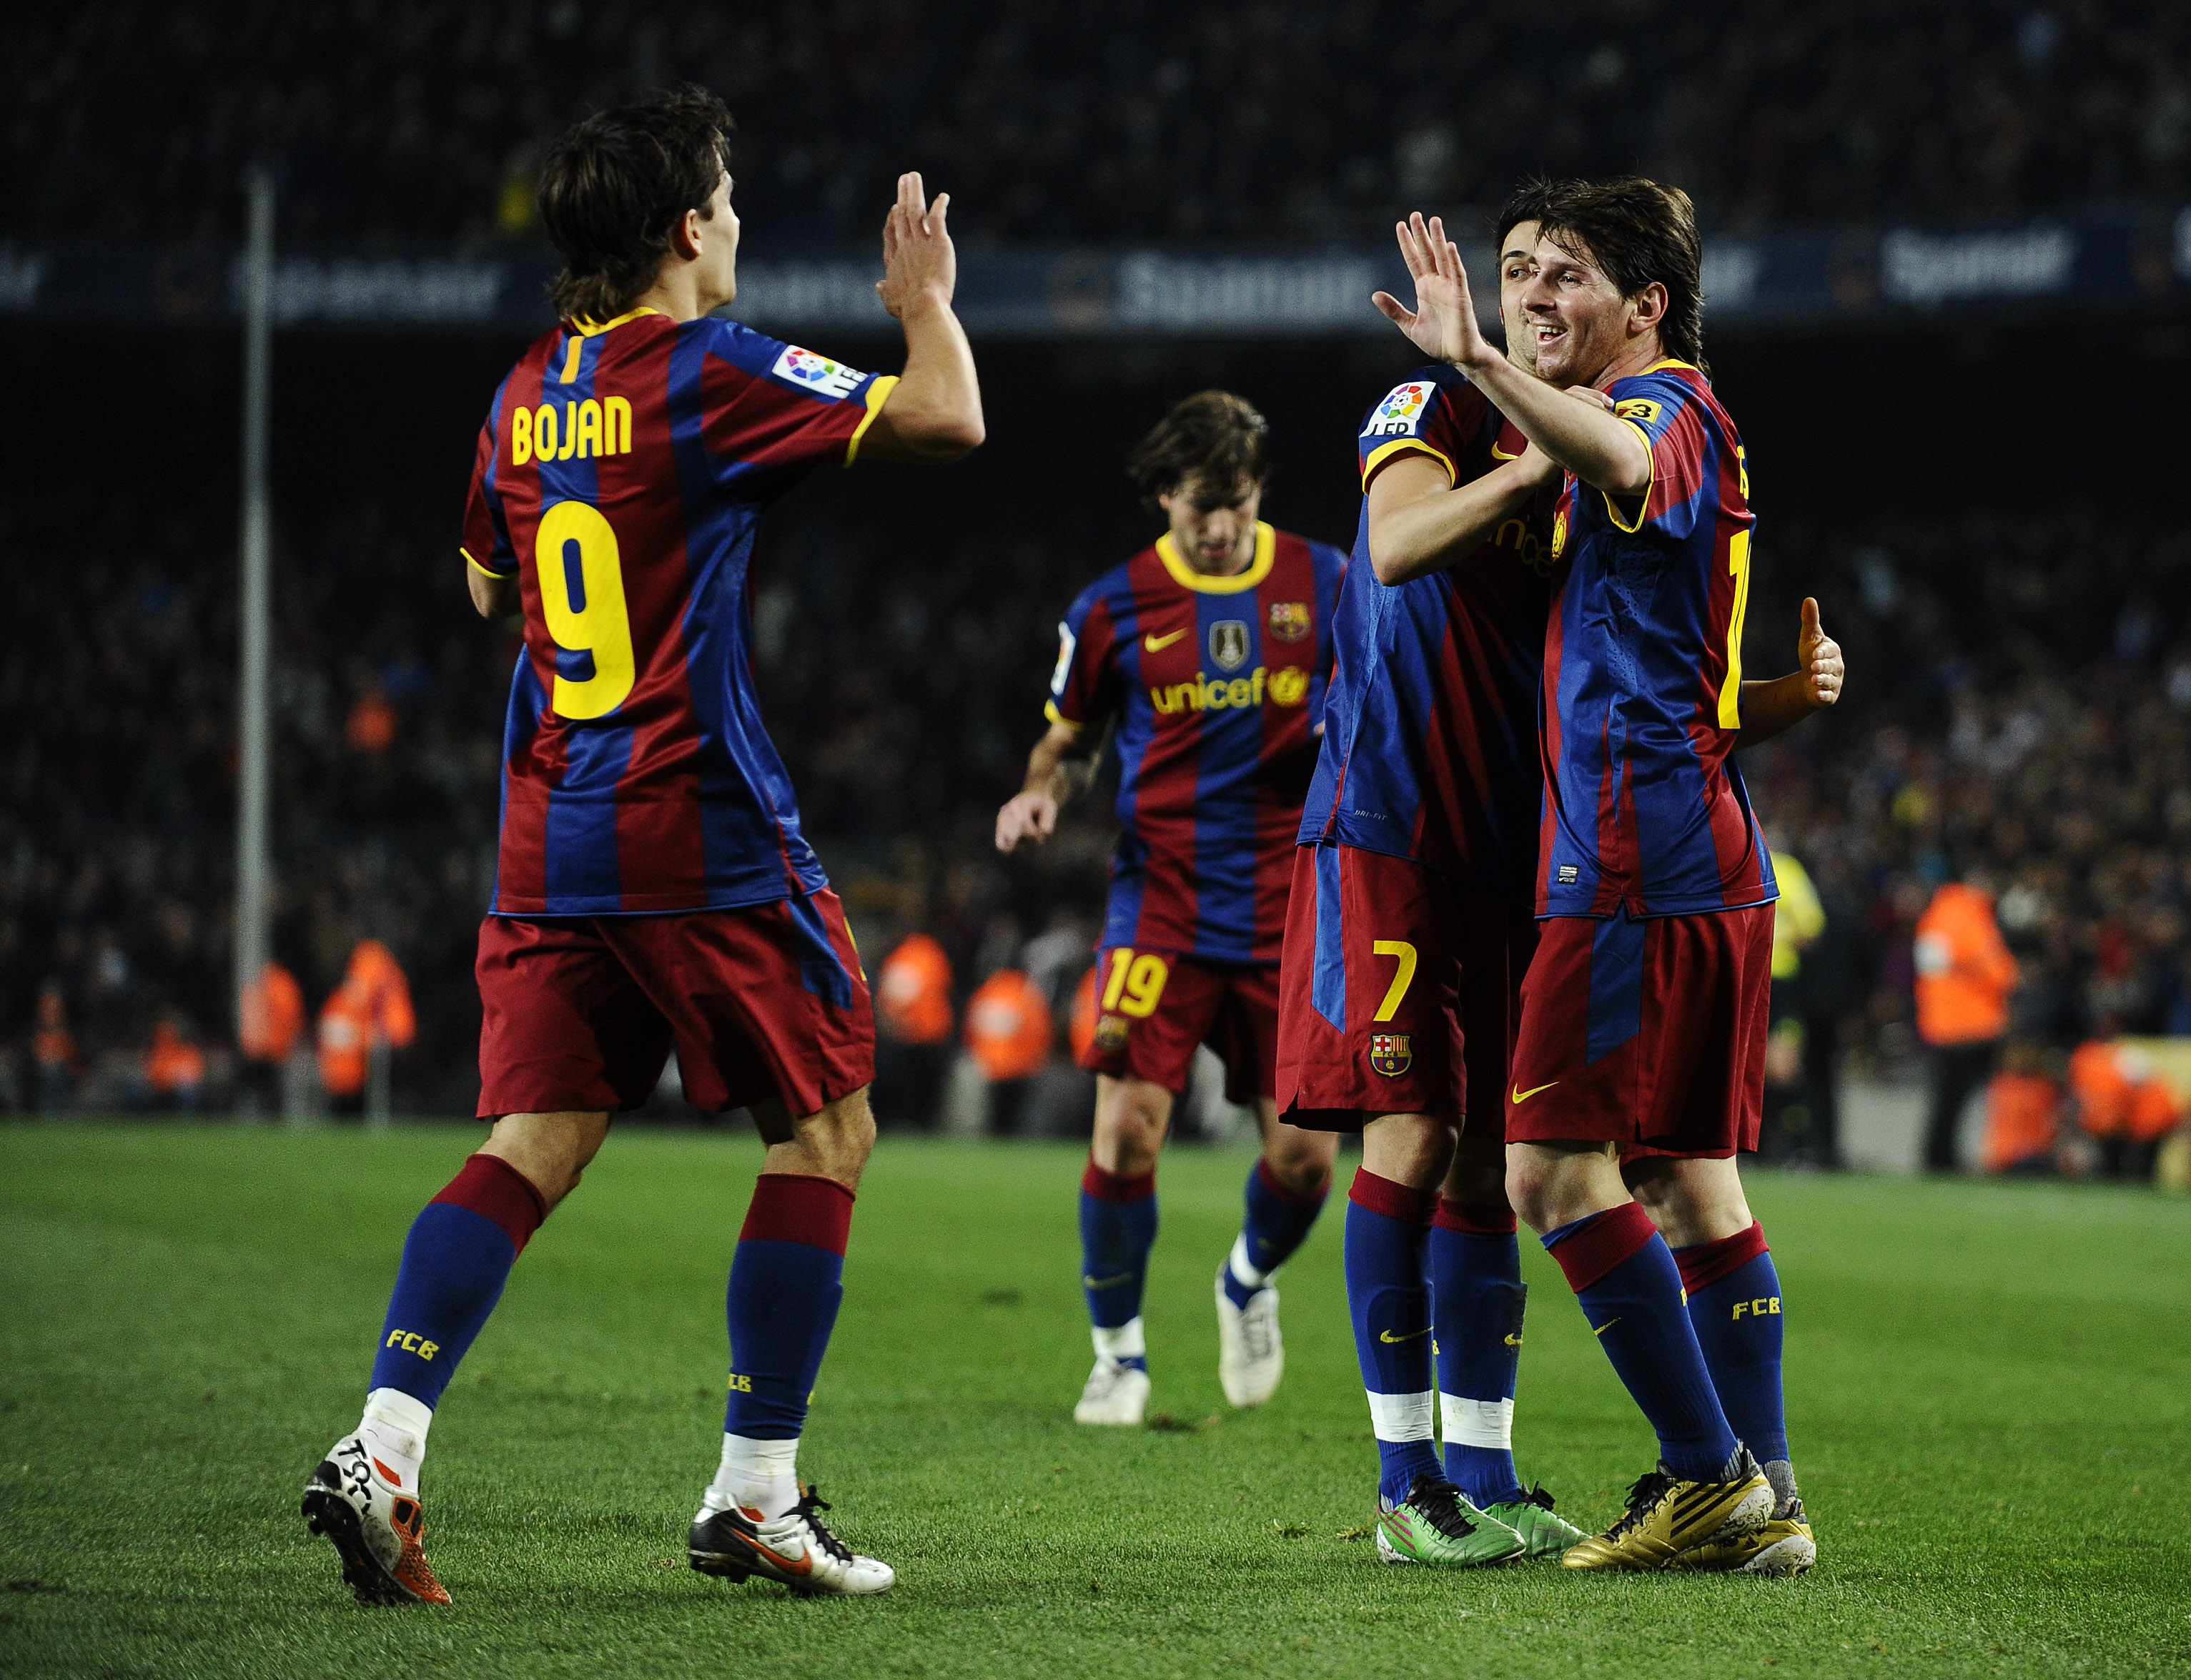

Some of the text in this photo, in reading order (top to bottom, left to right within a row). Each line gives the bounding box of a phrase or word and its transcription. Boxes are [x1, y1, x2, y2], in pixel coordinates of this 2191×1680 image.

[513, 396, 633, 466] BOJAN
[535, 500, 636, 720] 9
[1151, 666, 1268, 715] unicef
[1102, 947, 1169, 1019] 19
[1373, 939, 1418, 1022] 7
[1732, 1296, 1781, 1320] FCB
[386, 1328, 440, 1361] FCB
